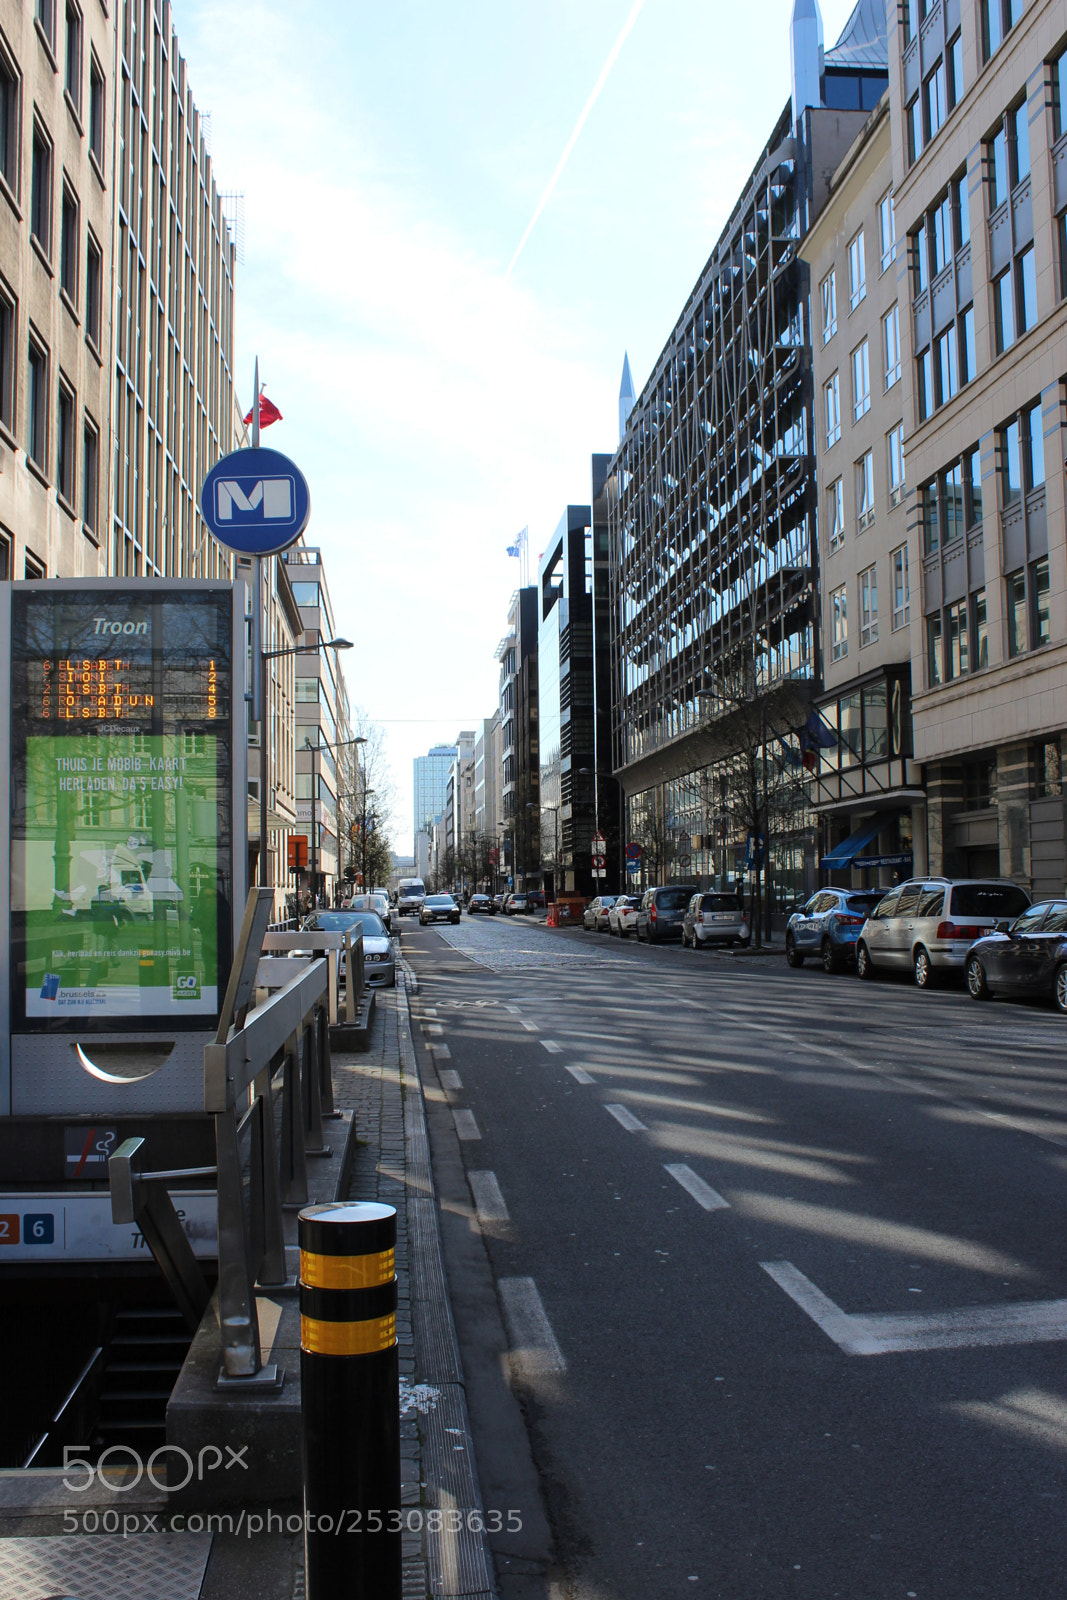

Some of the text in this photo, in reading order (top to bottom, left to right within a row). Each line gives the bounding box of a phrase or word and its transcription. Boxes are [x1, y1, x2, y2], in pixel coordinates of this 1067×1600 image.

[217, 479, 291, 520] M
[92, 618, 148, 635] Troon
[43, 659, 215, 671] 6 ELISABETH 1
[58, 671, 114, 683] SIMONIS
[208, 671, 217, 683] 2
[43, 683, 217, 695] 2 ELISABETH 4
[43, 696, 50, 706] 6
[208, 695, 217, 706] 5
[42, 707, 217, 718] 6 ELISABETH 8
[100, 724, 141, 733] JCDecaux
[55, 756, 187, 772] THUIS JE MOBIB-KAART
[59, 776, 184, 793] HERLADEN, DA'S EASY!
[103, 949, 117, 957] reis
[176, 975, 197, 989] GO
[0, 1220, 45, 1238] 2 6
